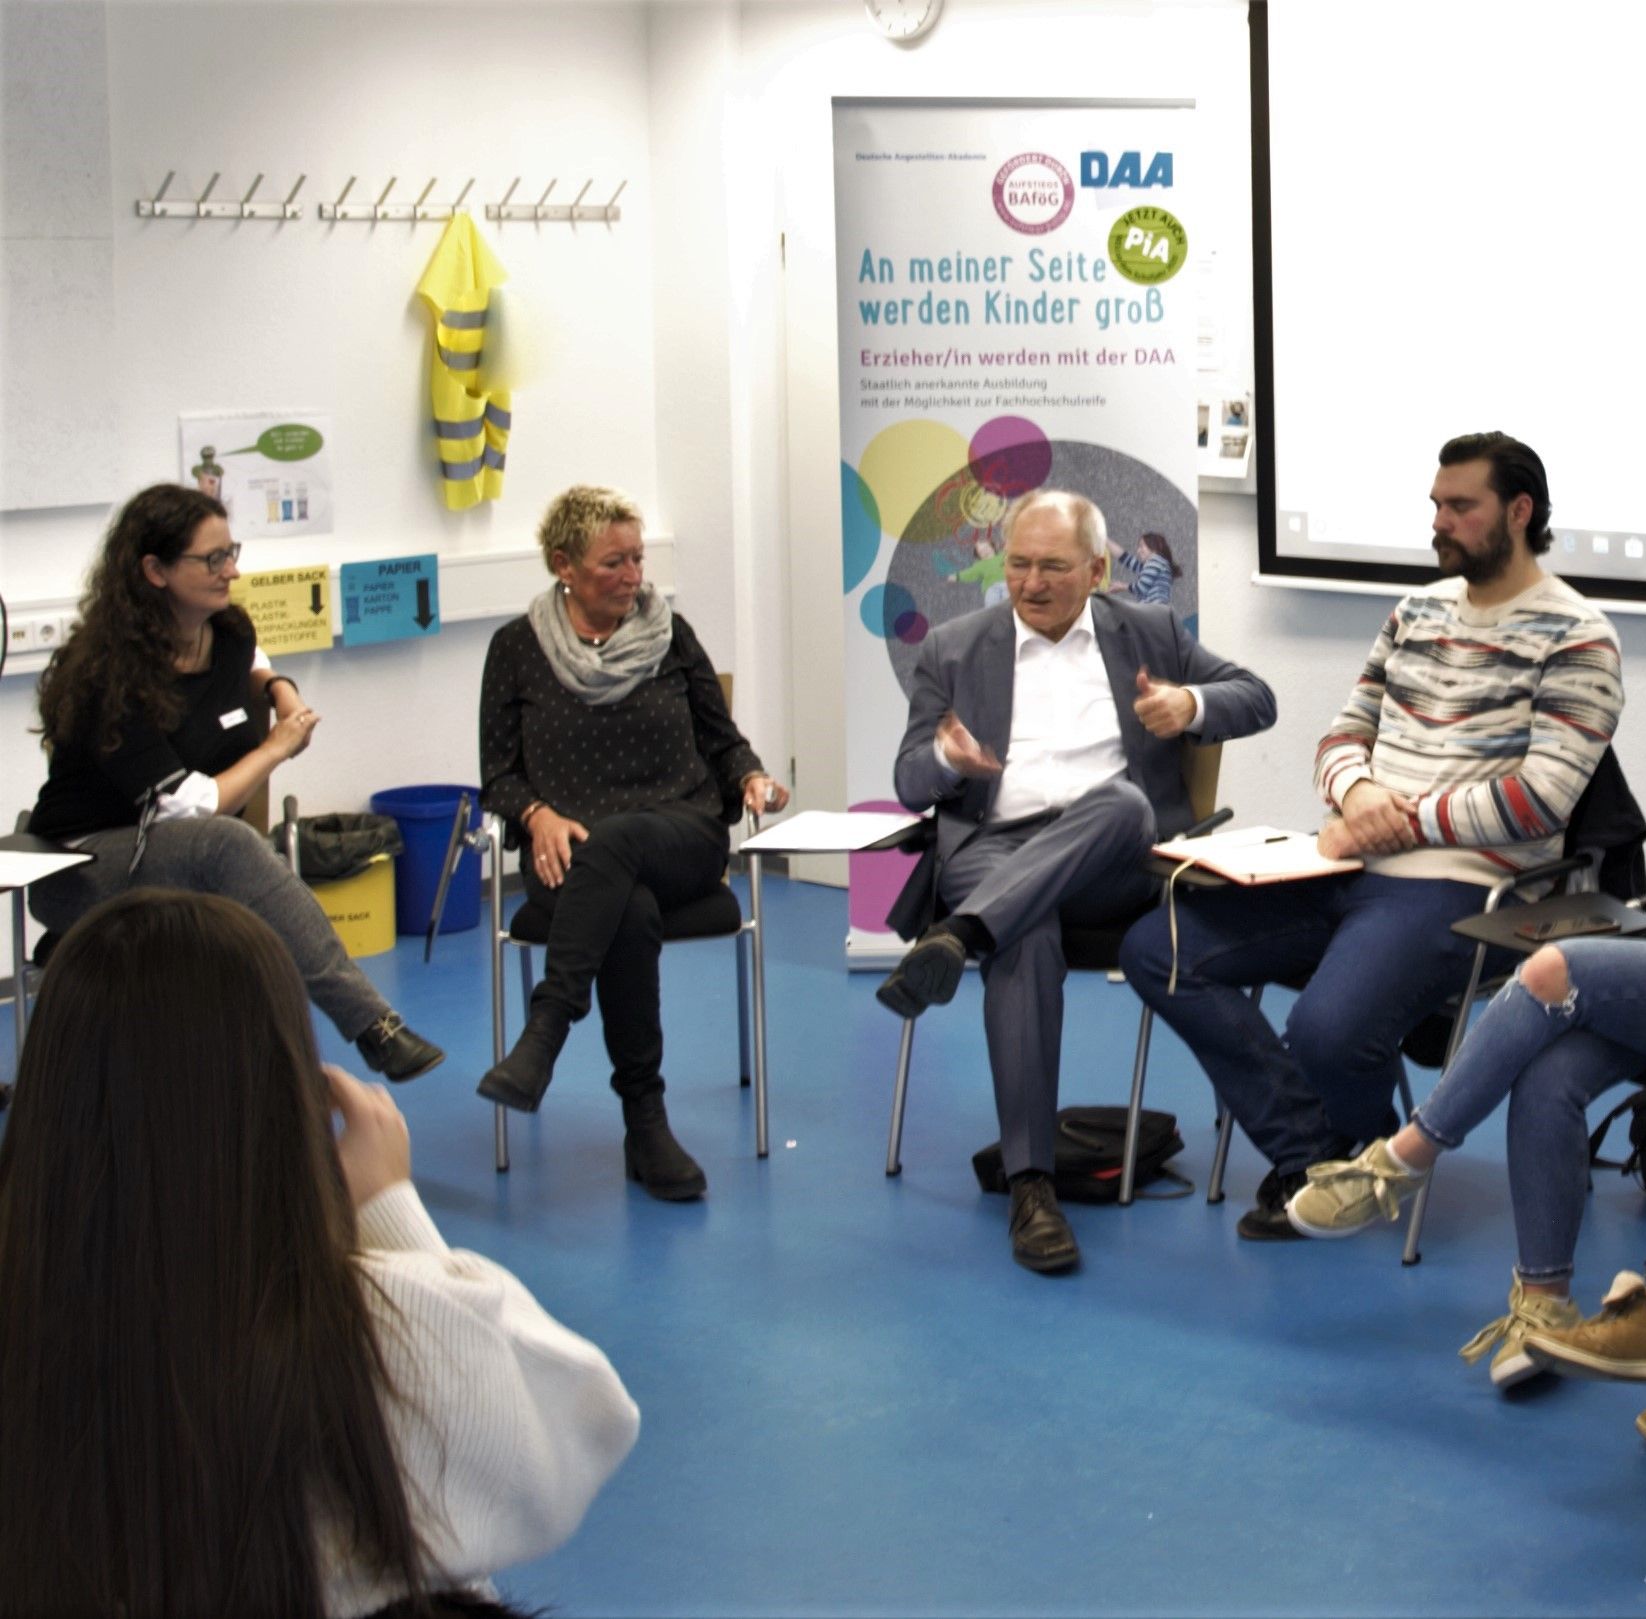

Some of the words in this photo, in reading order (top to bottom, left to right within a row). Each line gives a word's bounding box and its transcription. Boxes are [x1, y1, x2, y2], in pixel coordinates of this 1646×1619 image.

[1080, 151, 1173, 188] DAA
[1008, 180, 1060, 190] AUFSTIEGS
[1008, 191, 1060, 207] BAföG
[1123, 207, 1157, 226] JETZT
[1160, 213, 1185, 245] AUCH
[1123, 226, 1170, 264] PiA
[859, 248, 894, 283] An
[909, 251, 1013, 283] meiner
[1028, 248, 1106, 283] Seite
[859, 290, 970, 325] werden
[984, 290, 1080, 325] Kinder
[1095, 287, 1165, 331] groß
[860, 348, 973, 368] Erzieher/in
[978, 348, 1051, 367] werden
[1057, 349, 1090, 366] mit
[1095, 348, 1128, 366] der
[1134, 348, 1177, 366] DAA
[860, 379, 911, 391] Staatlich
[914, 379, 980, 390] anerkannte
[983, 378, 1048, 392] Ausbildung
[860, 396, 879, 409] mit
[881, 396, 901, 409] der
[904, 395, 971, 410] Möglichkeit
[974, 398, 992, 408] zur
[995, 395, 1107, 408] Fachhochschulreife
[378, 561, 421, 576] PAPIER
[251, 574, 295, 589] GELBER
[297, 570, 327, 584] SACK
[363, 581, 395, 593] PAPIER
[250, 599, 288, 611] PLASTIK
[364, 592, 400, 604] KARTON
[254, 618, 327, 634] ERPACKUNGEN
[258, 631, 319, 646] UNSTSTOFFE
